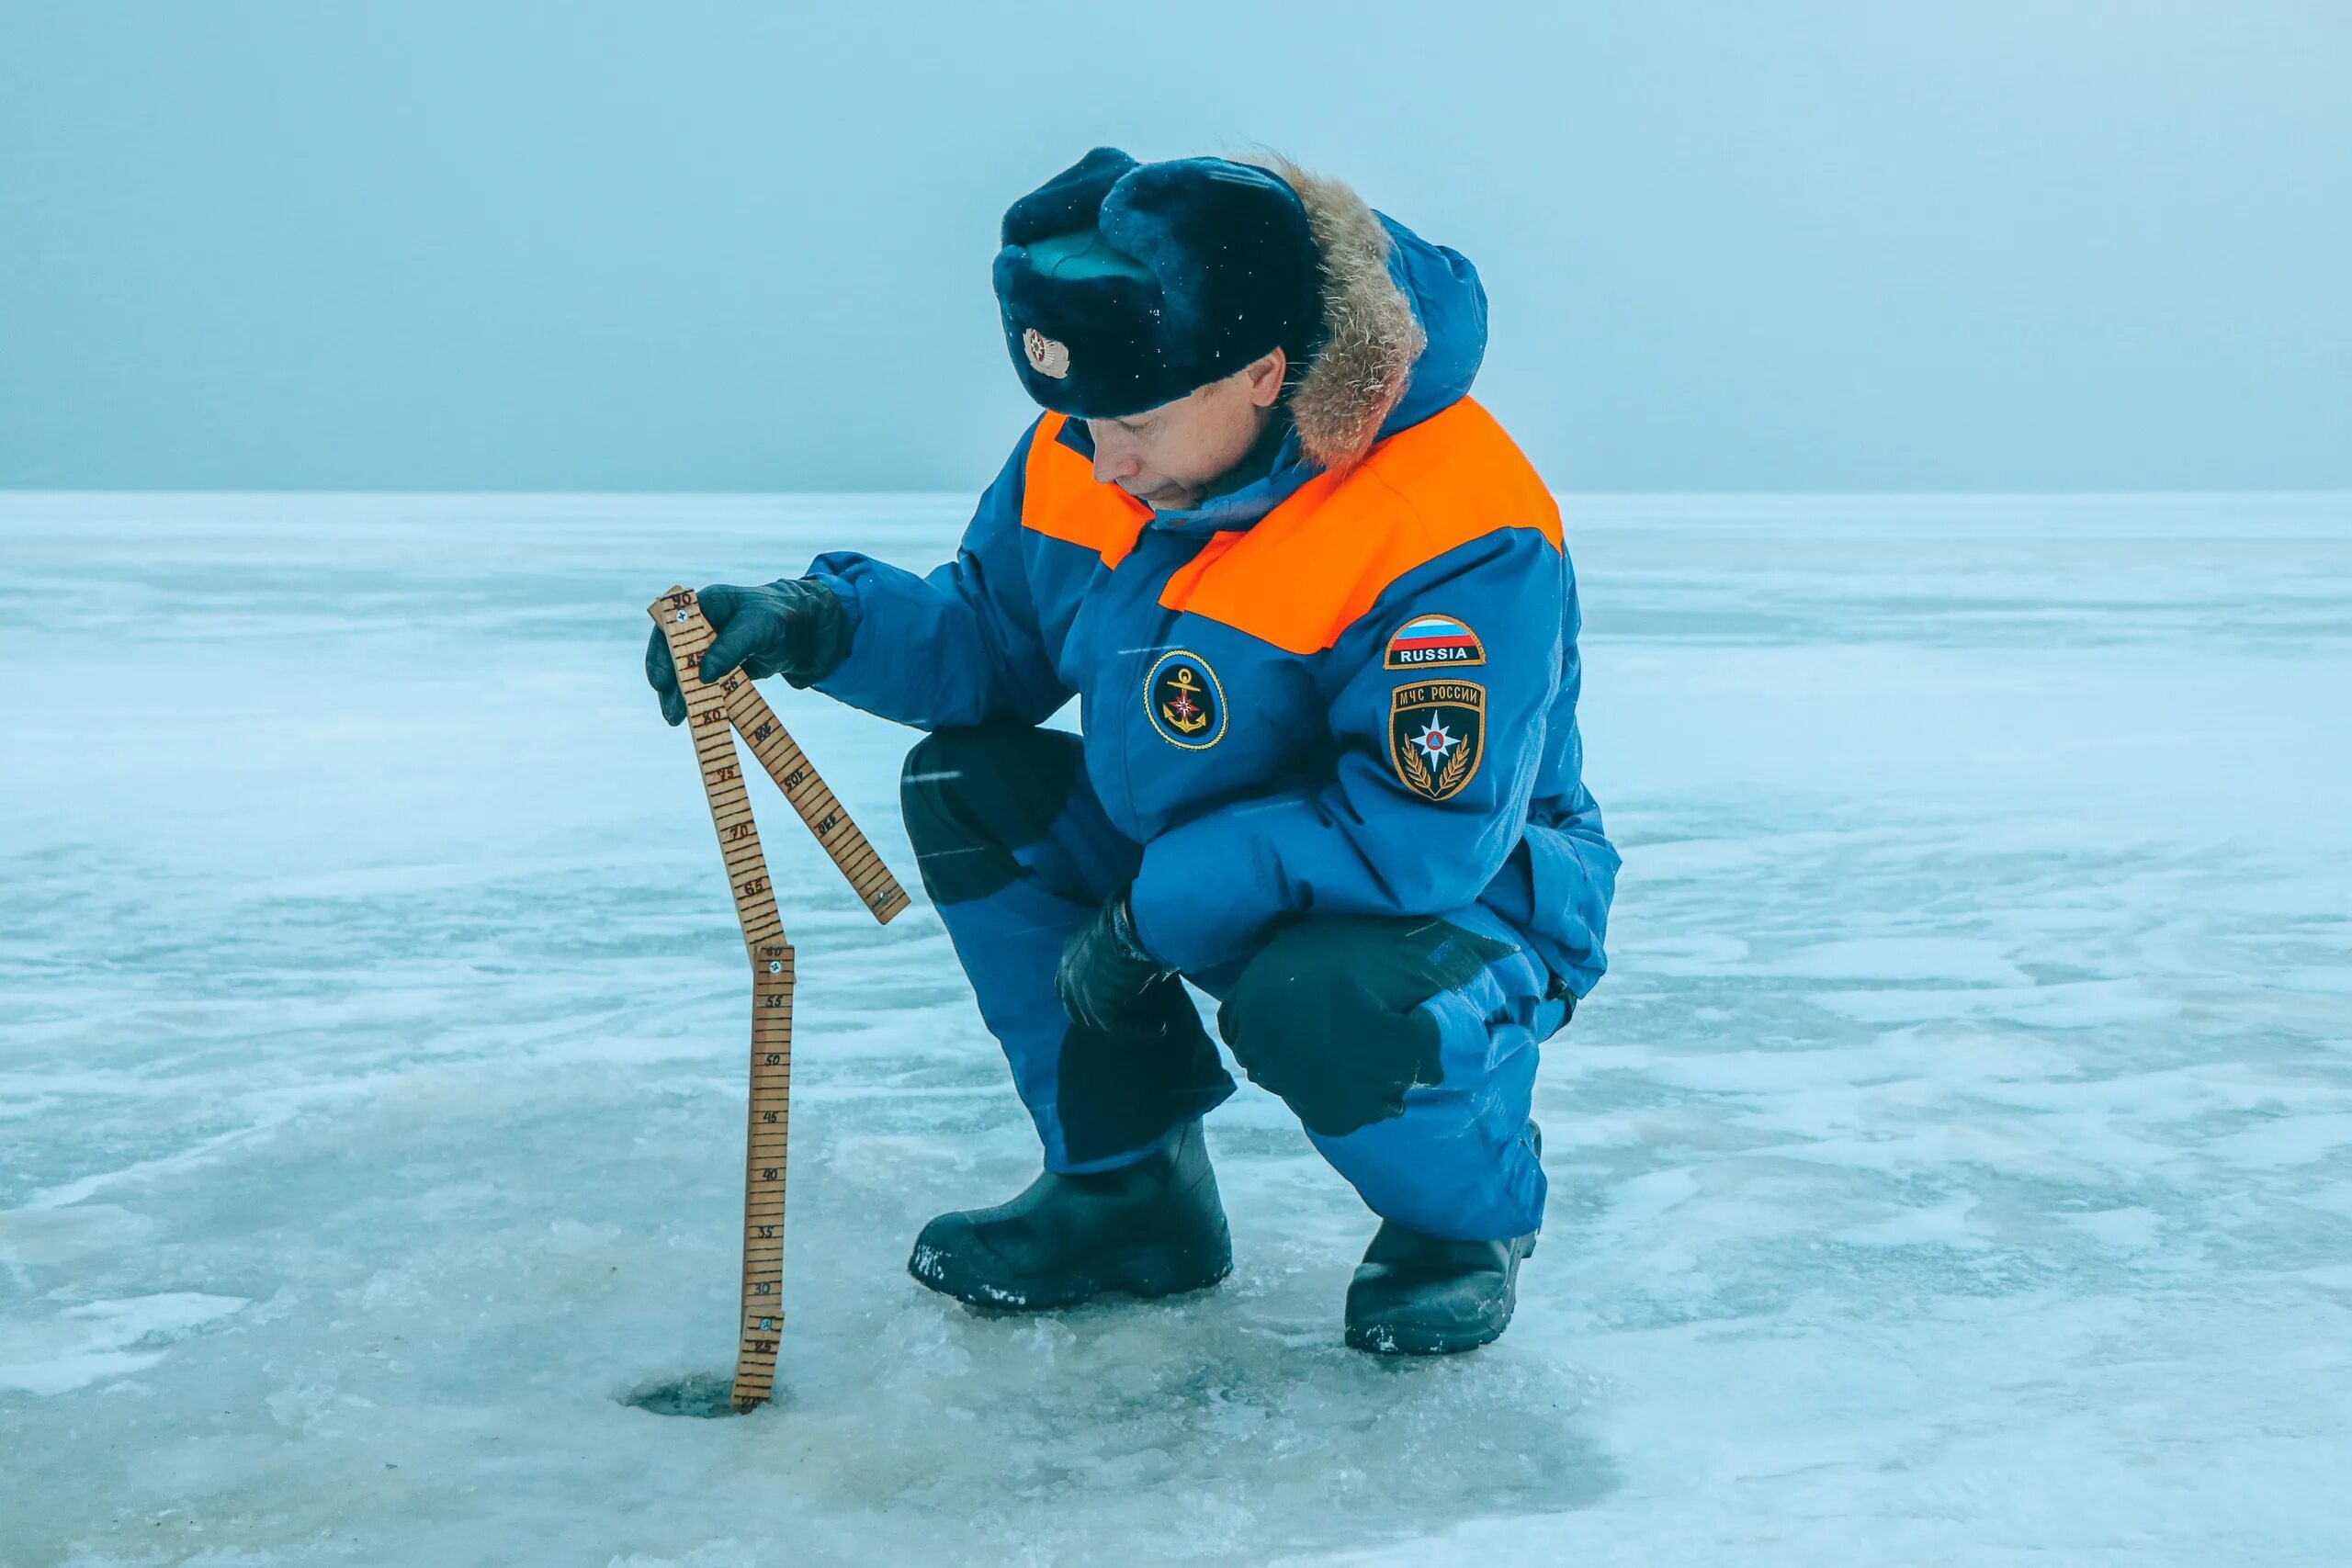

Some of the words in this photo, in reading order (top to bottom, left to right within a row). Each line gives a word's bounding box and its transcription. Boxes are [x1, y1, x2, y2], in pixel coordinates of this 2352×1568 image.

[671, 592, 692, 607] 90
[1400, 648, 1467, 662] RUSSIA
[719, 676, 739, 694] 95
[1400, 688, 1425, 705] МЧС
[1431, 686, 1477, 704] РОССИИ
[702, 708, 721, 726] 80
[718, 766, 735, 782] 75
[729, 824, 749, 839] 70
[744, 878, 763, 897] 65
[764, 994, 784, 1009] 55
[764, 1054, 781, 1066] 50
[763, 1110, 779, 1123] 45
[762, 1168, 778, 1181] 40
[757, 1225, 775, 1238] 35
[754, 1282, 771, 1295] 30
[754, 1341, 773, 1353] 25
